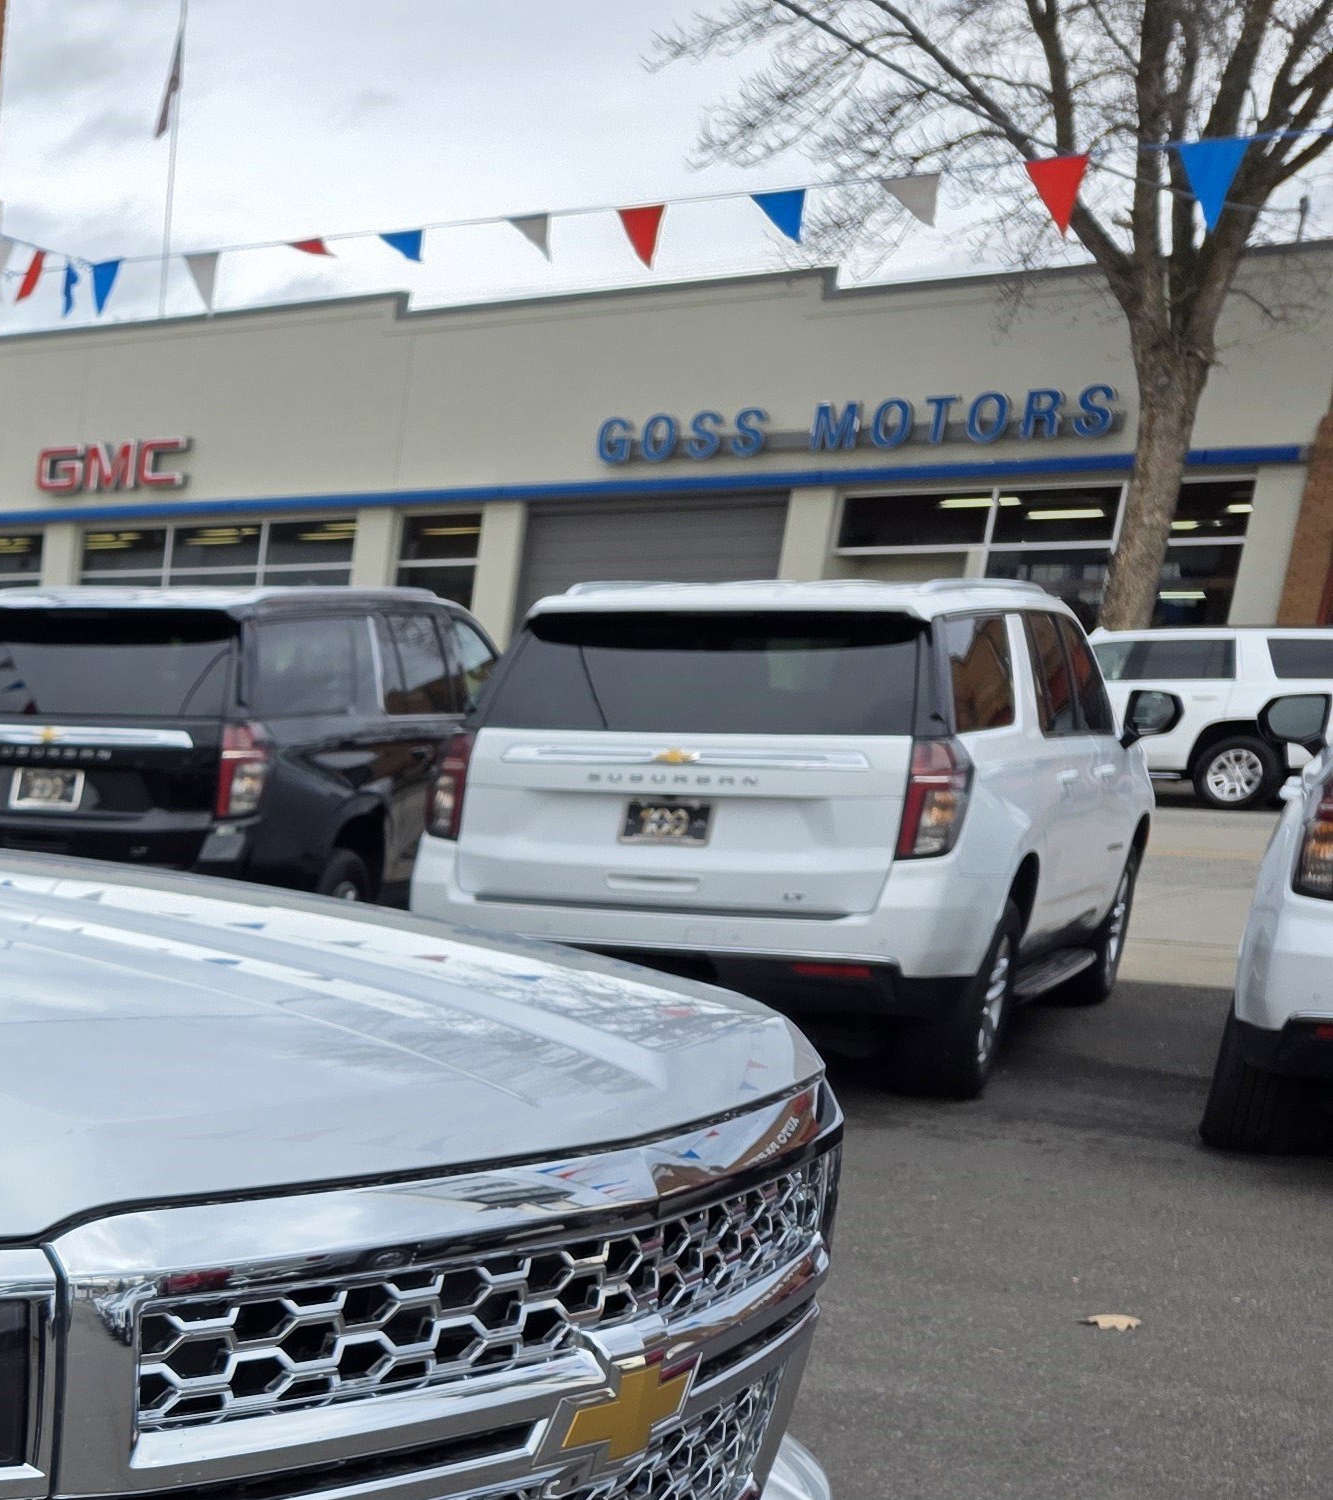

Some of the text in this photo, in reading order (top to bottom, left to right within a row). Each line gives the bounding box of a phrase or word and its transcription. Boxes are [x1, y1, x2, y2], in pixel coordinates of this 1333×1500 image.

[595, 383, 1122, 464] GOSS MOTORS
[36, 438, 190, 493] GMC
[586, 771, 760, 787] SUBURBAN
